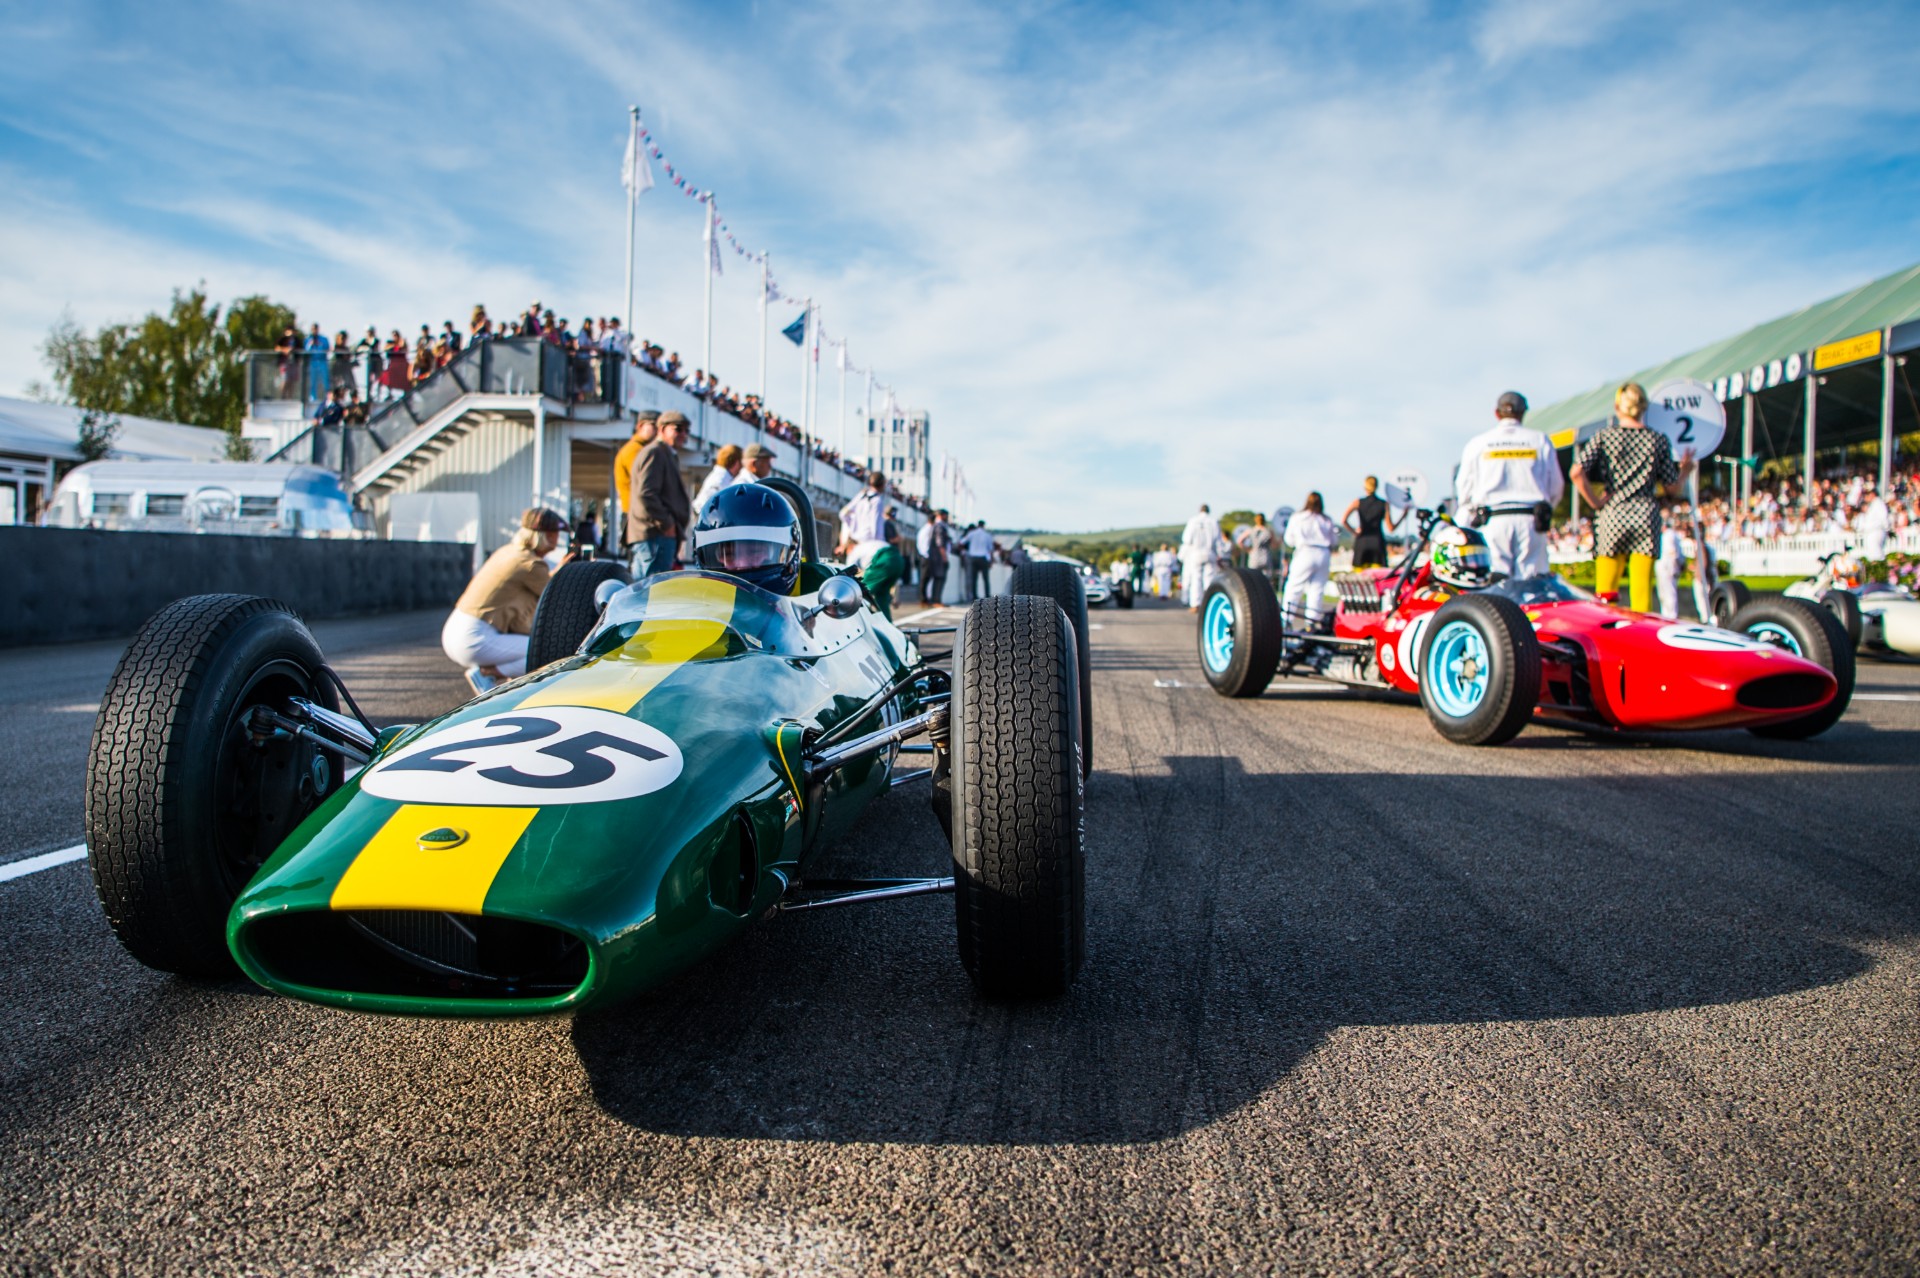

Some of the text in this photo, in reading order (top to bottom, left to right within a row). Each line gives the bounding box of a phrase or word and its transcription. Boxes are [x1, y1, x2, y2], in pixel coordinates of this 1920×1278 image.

[1664, 396, 1701, 411] ROW
[1676, 416, 1695, 444] 2
[377, 716, 670, 789] 25
